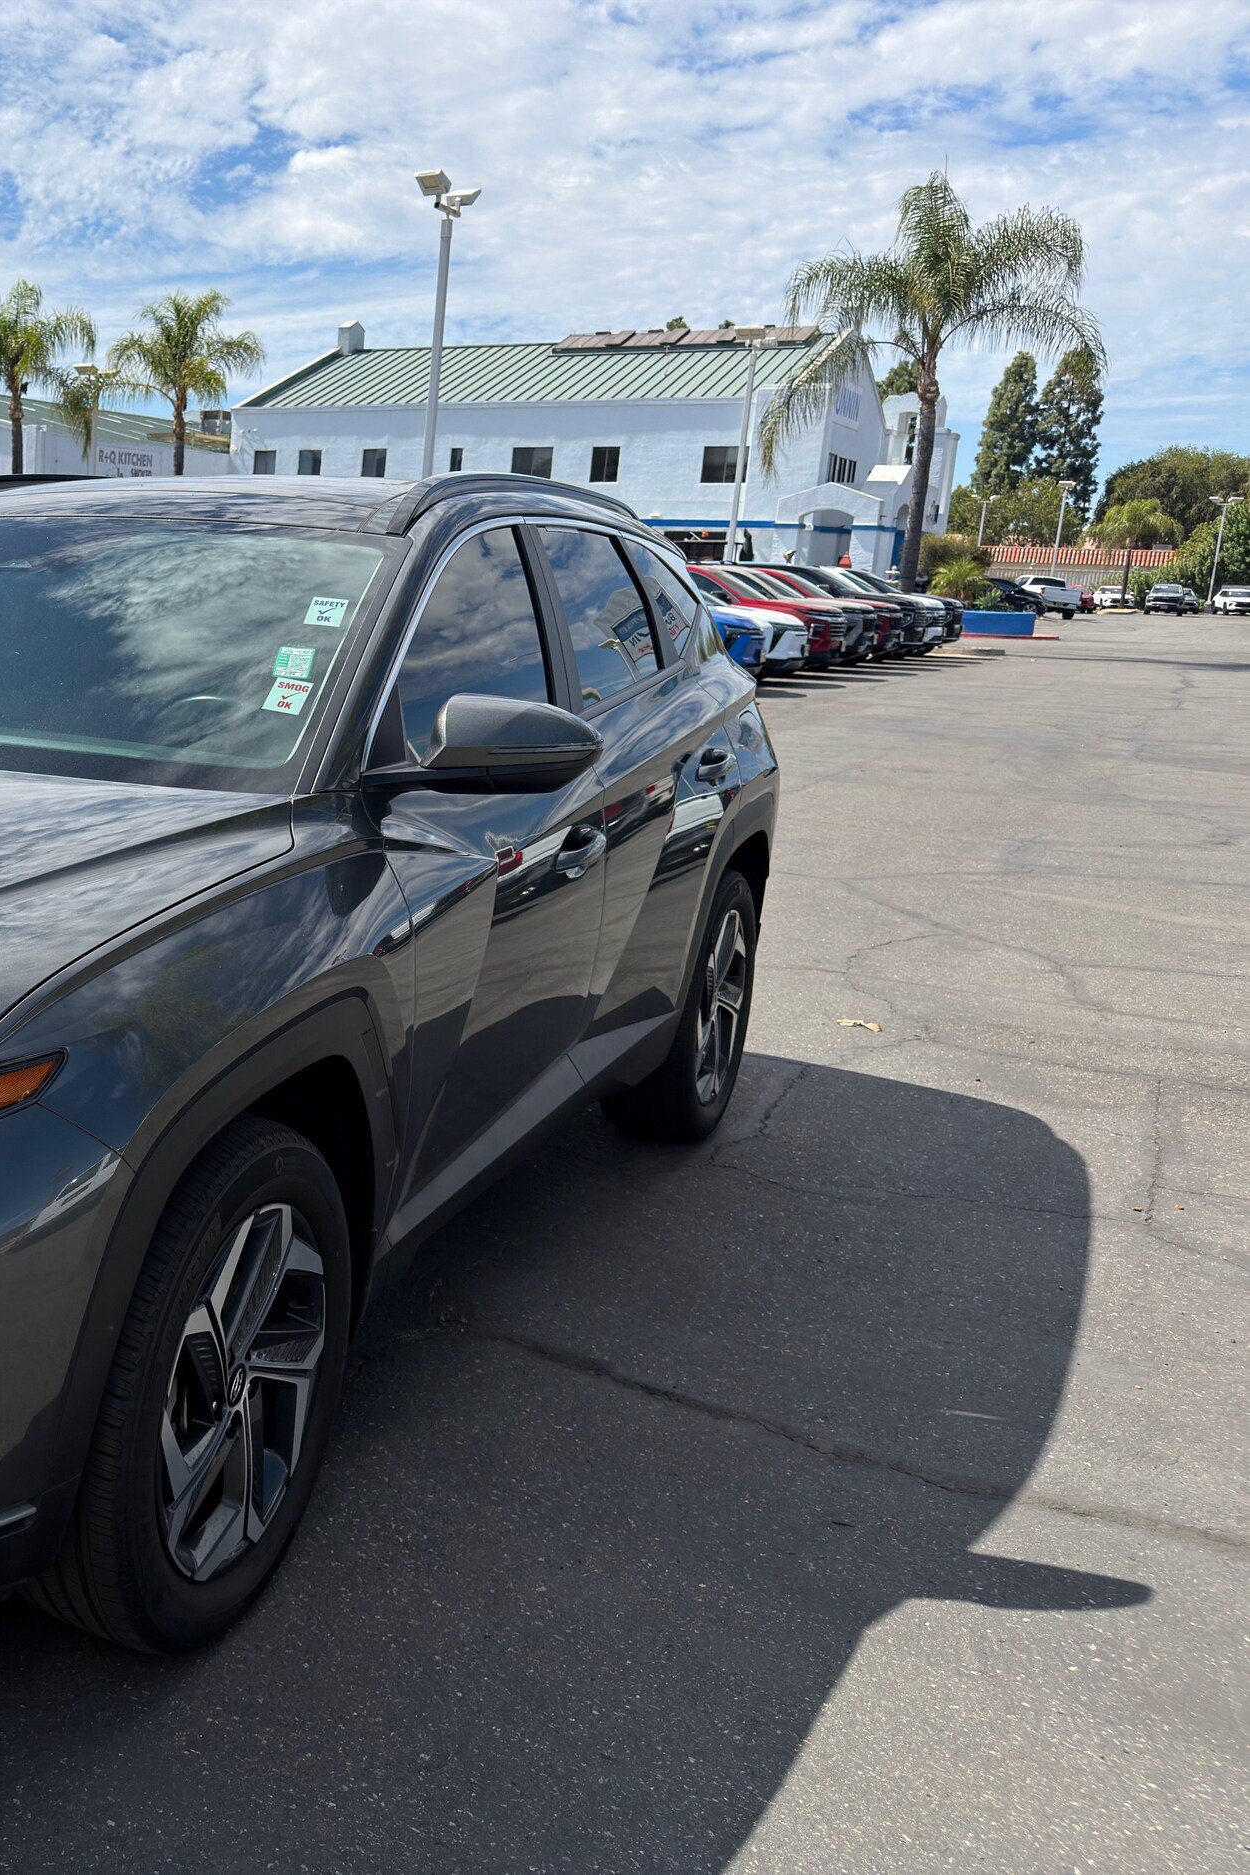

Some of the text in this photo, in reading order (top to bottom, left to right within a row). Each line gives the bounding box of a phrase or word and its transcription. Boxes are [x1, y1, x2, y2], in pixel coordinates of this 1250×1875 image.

[118, 450, 153, 468] KITCHEN
[313, 599, 345, 609] SAFETY
[316, 615, 331, 623] OK
[277, 681, 310, 693] SMOG
[277, 700, 293, 710] OK
